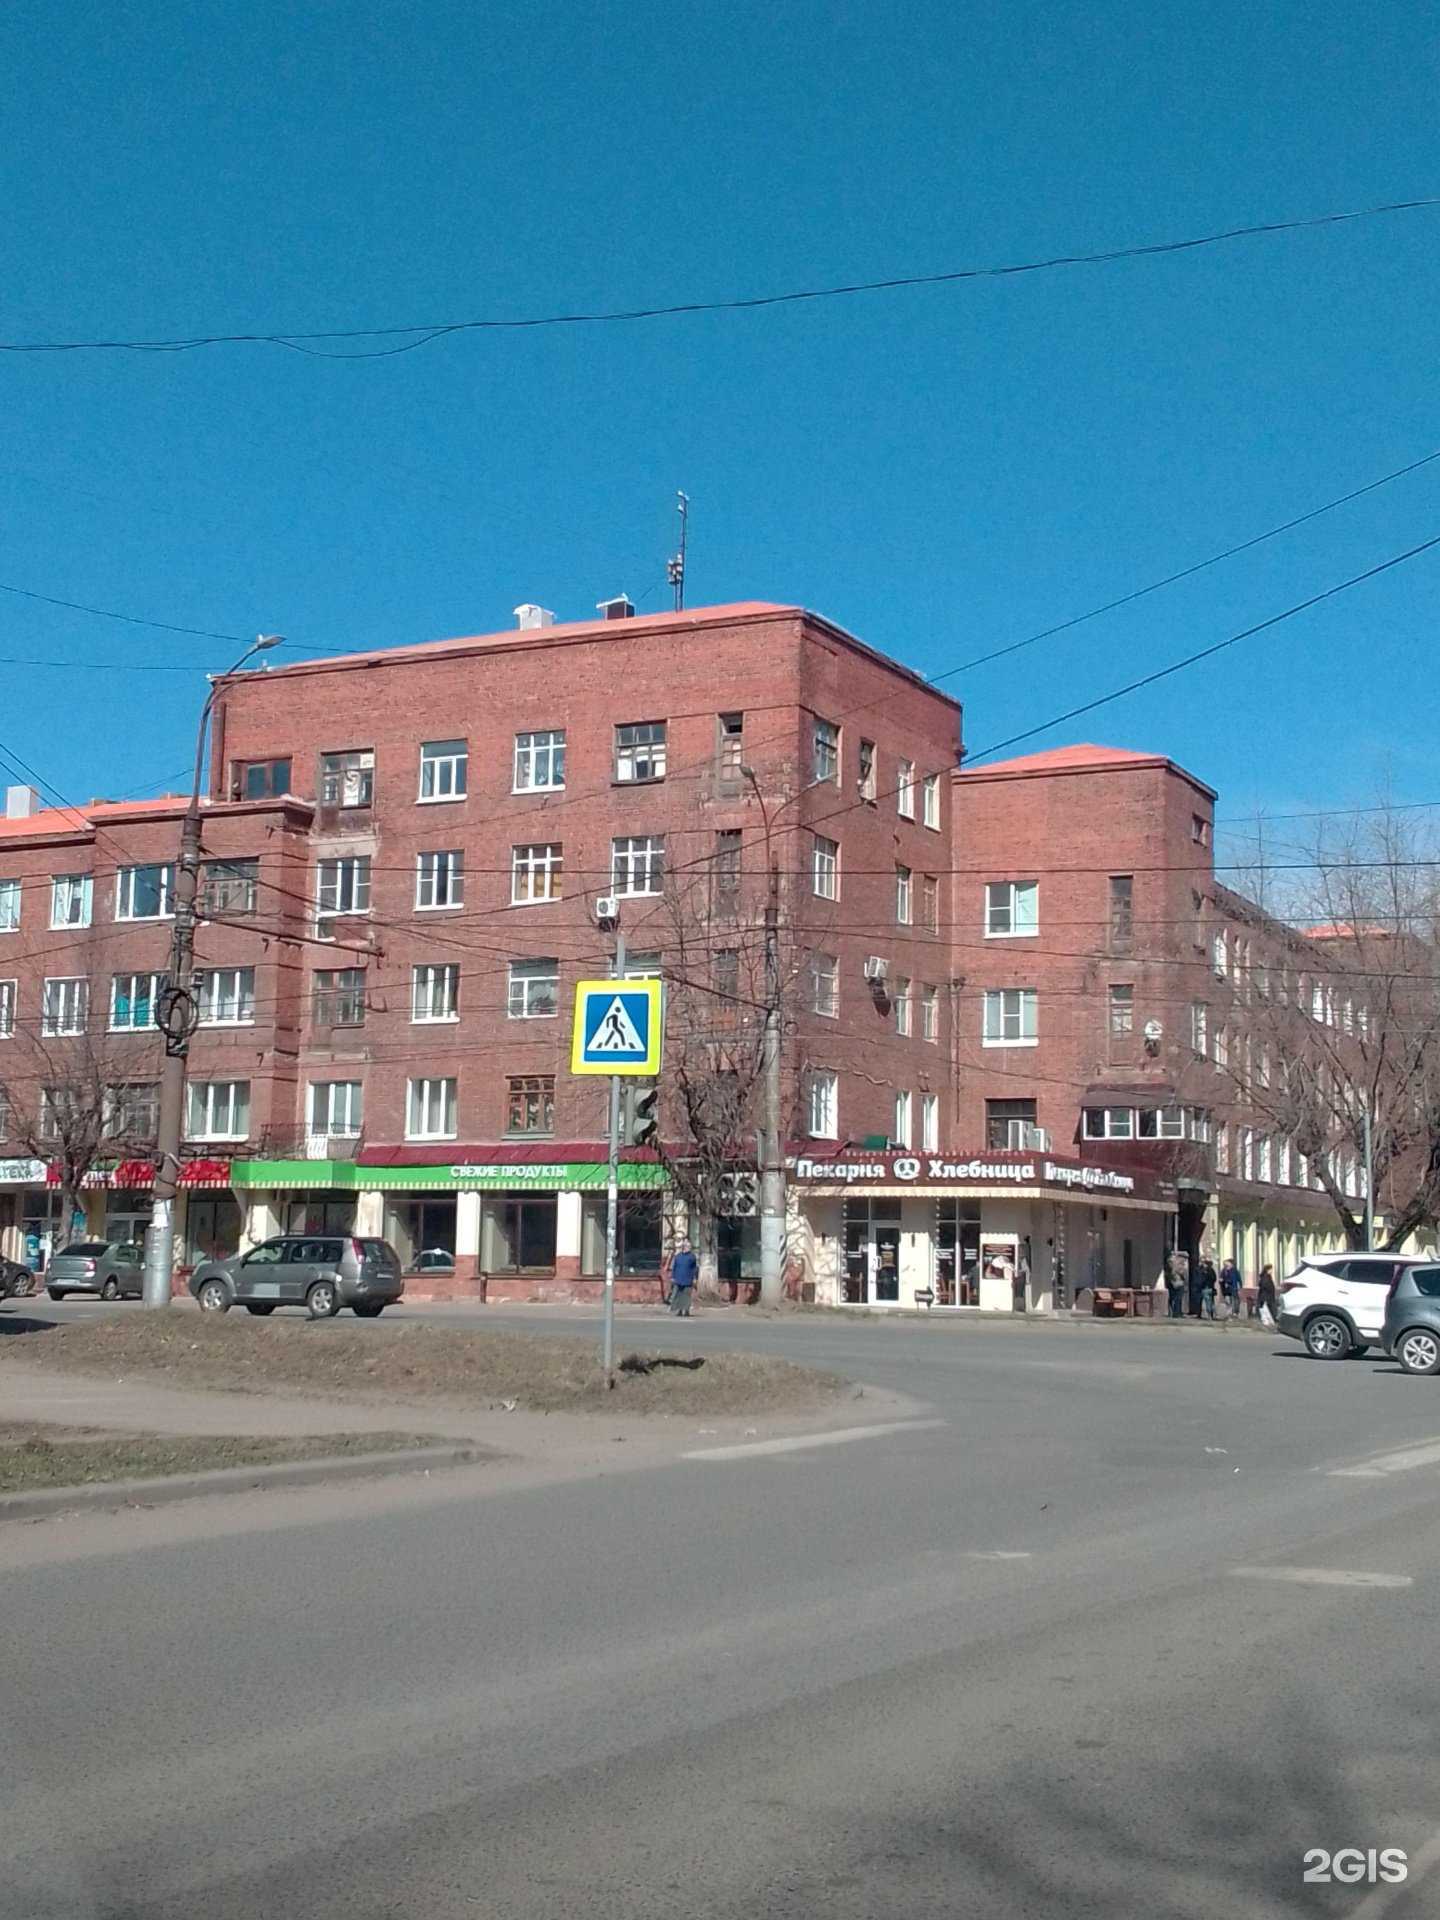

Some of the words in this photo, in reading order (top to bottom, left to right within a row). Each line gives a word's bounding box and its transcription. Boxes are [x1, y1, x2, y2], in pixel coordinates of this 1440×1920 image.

[450, 1166, 498, 1178] СВЕЖИЕ
[501, 1165, 567, 1179] ПРОДУКТЫ
[797, 1160, 886, 1182] Пекарня
[928, 1160, 1036, 1182] Хлебница
